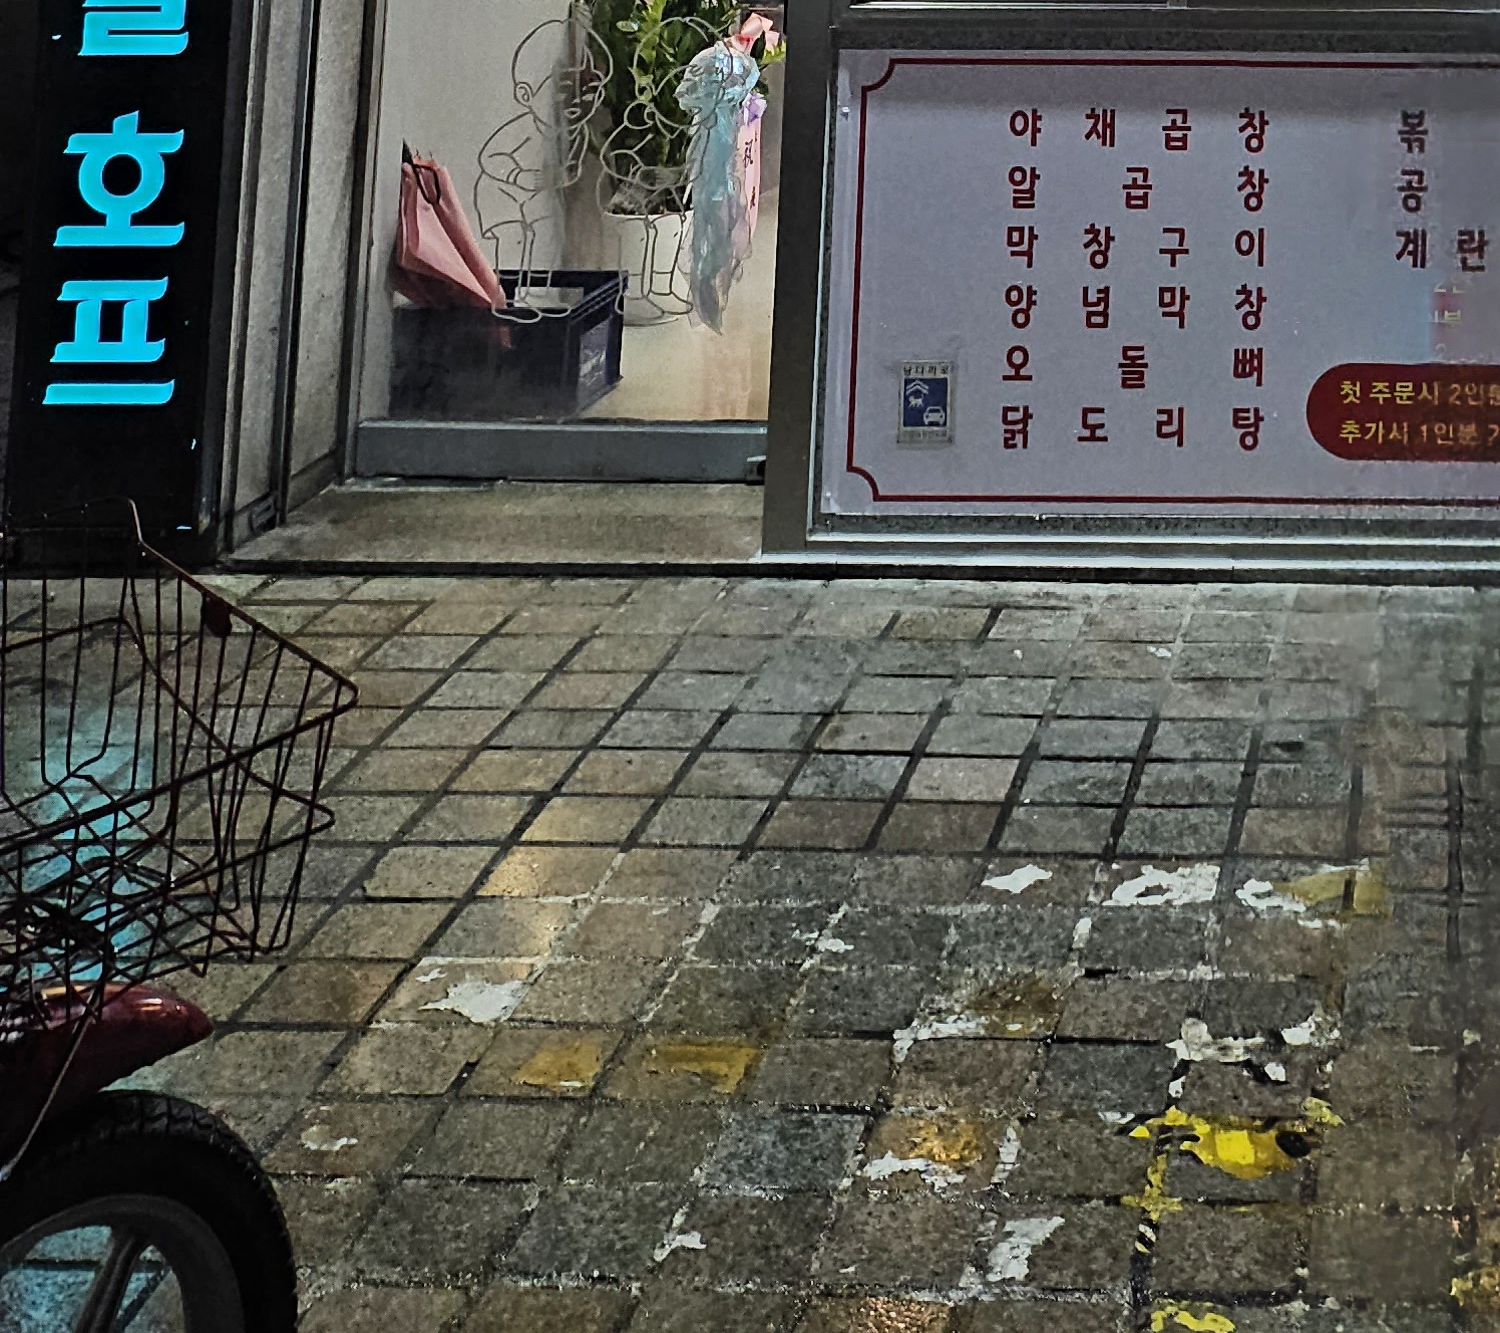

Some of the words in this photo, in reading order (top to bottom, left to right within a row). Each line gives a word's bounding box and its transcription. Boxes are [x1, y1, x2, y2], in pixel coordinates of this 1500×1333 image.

[1339, 381, 1361, 404] 첫
[1369, 381, 1439, 405] 주문시
[1339, 420, 1409, 445] 추가시
[1420, 422, 1478, 446] 1인분
